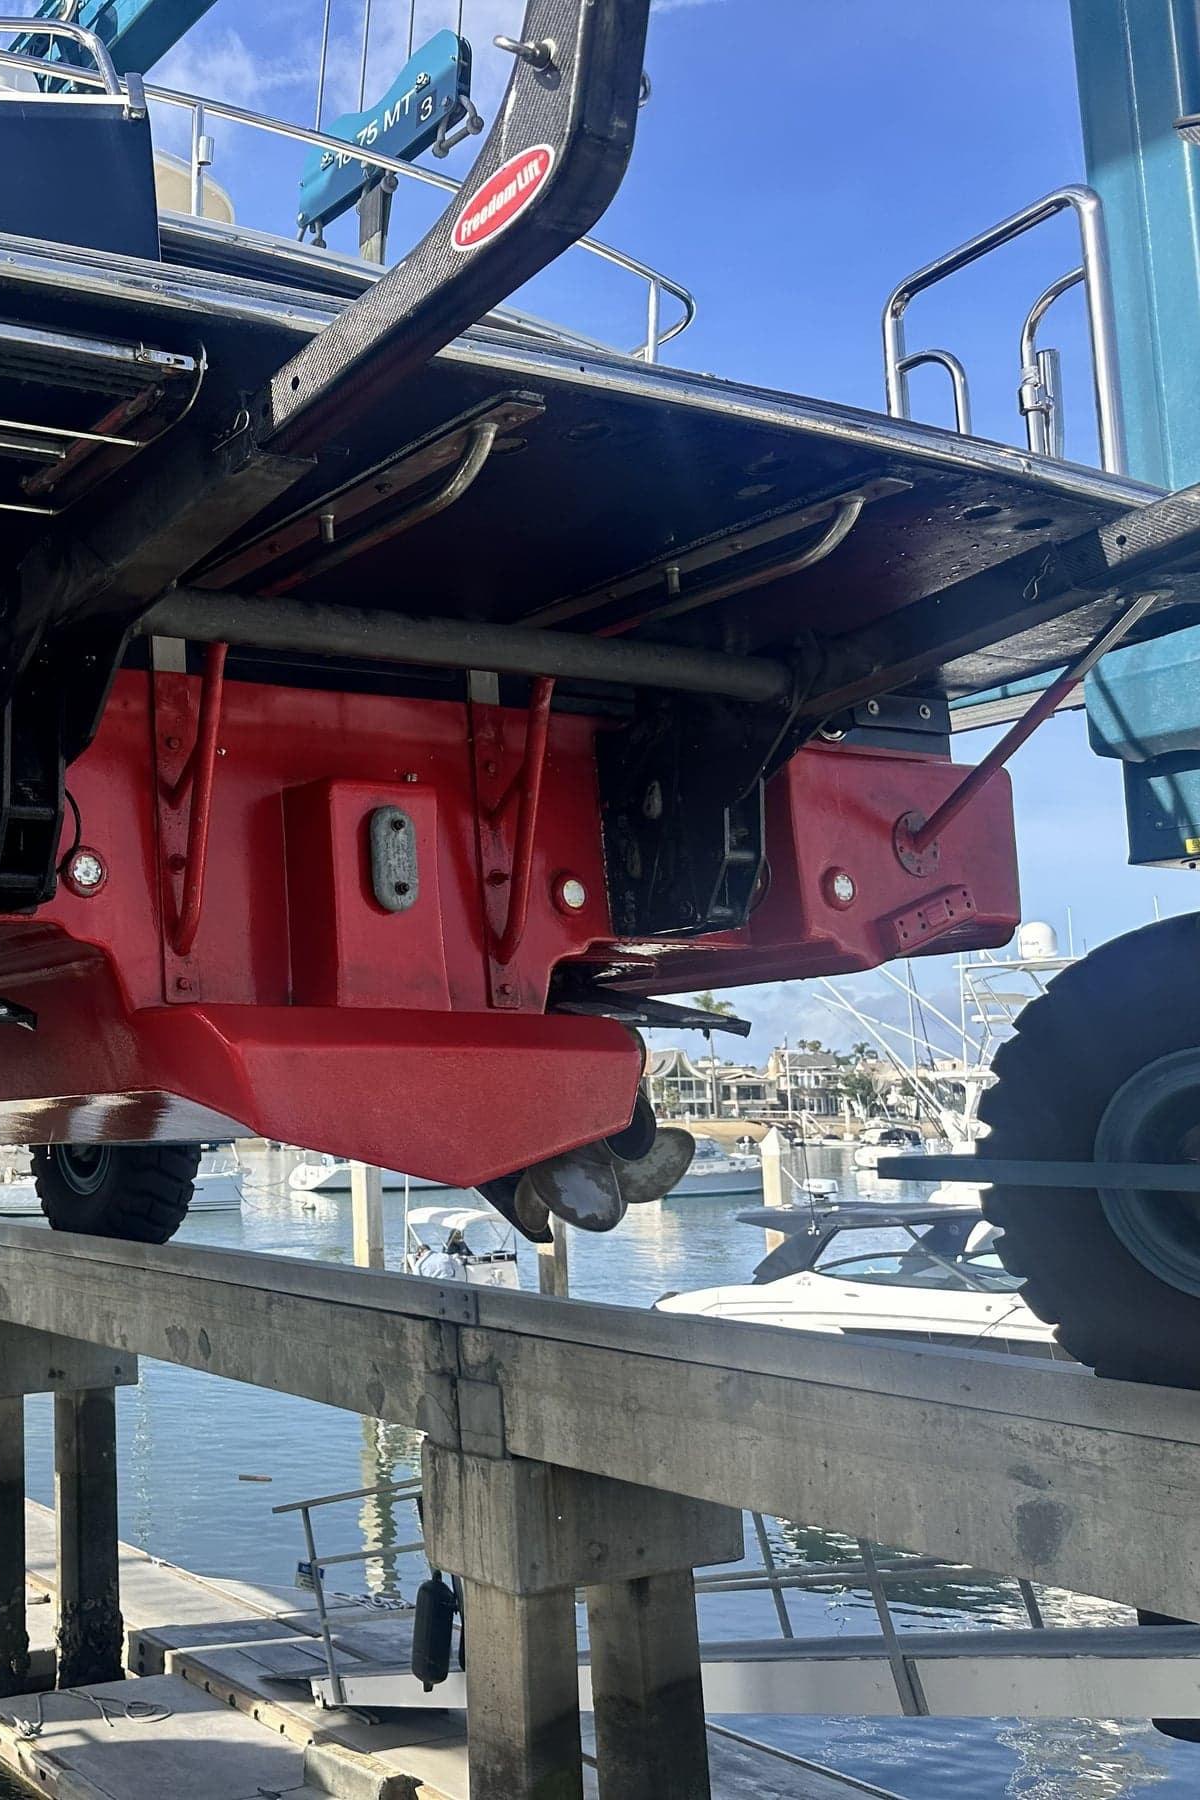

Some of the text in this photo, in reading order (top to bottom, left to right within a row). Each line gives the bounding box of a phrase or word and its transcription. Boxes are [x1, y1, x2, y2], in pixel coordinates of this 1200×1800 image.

[384, 87, 416, 132] MT
[420, 95, 433, 121] 3
[461, 180, 517, 241] Freedom
